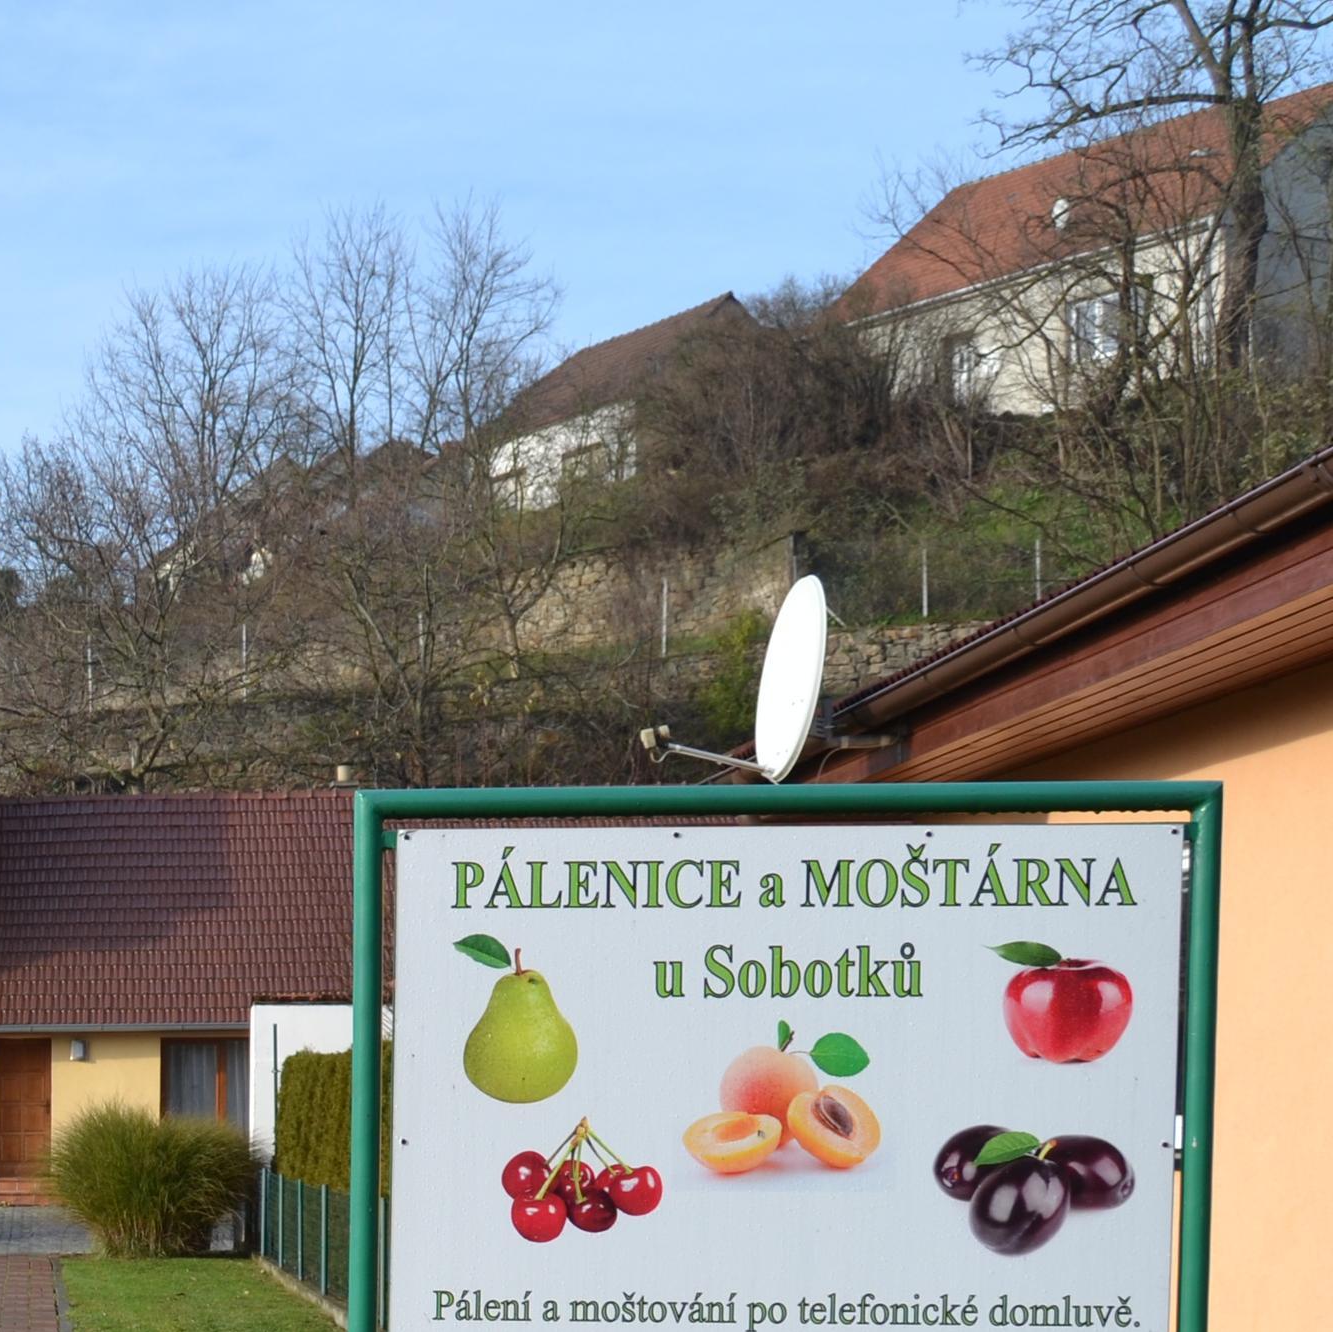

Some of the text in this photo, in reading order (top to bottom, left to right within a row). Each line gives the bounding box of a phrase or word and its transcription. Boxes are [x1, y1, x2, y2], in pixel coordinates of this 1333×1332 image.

[450, 842, 1139, 910] PÁLENICE a MOŠTÁRNA
[652, 941, 924, 999] u Sobotků
[431, 1289, 1142, 1332] Pálení a moštování po telefonické domluvě.
